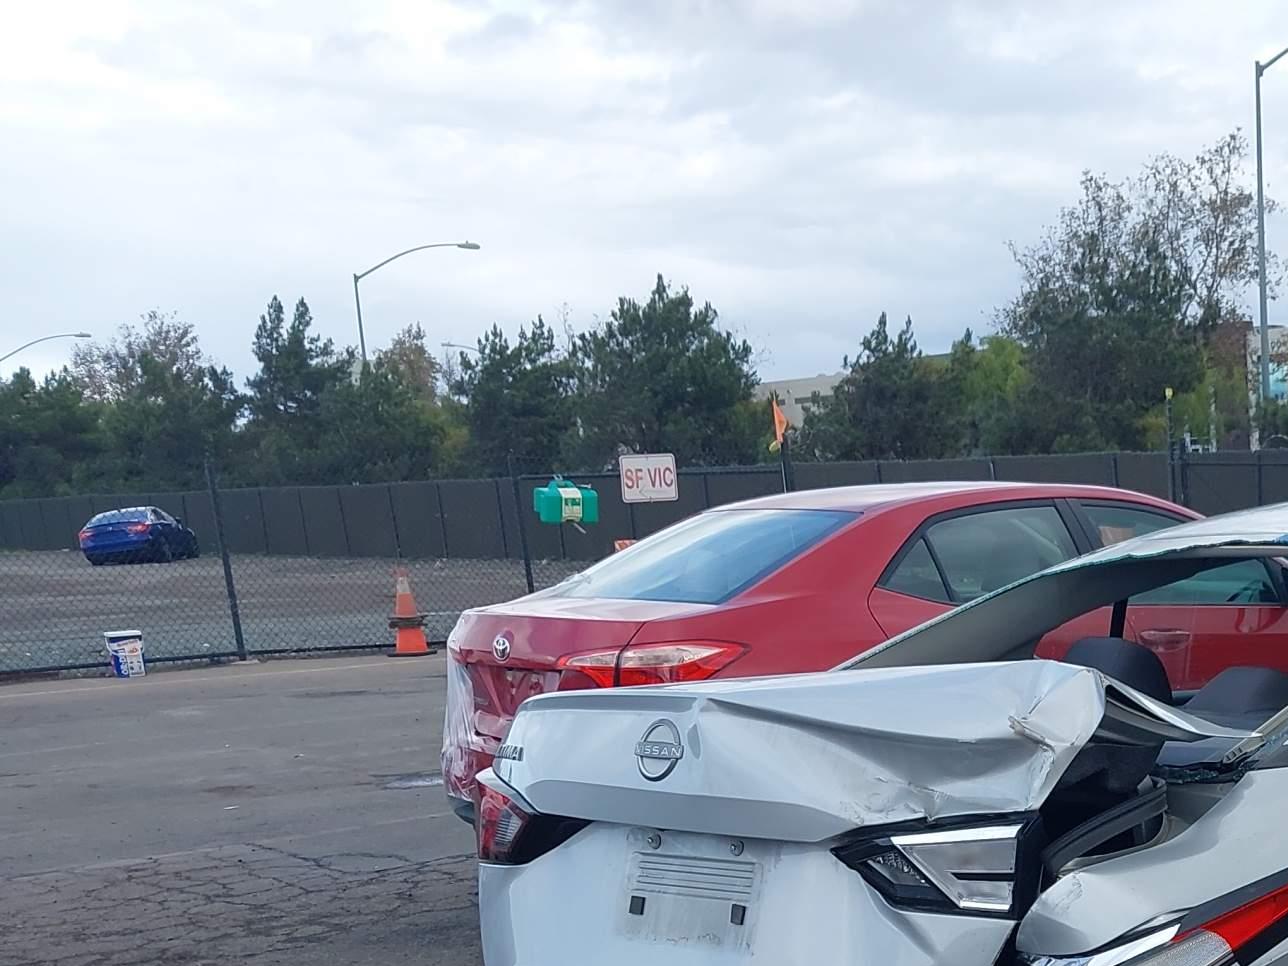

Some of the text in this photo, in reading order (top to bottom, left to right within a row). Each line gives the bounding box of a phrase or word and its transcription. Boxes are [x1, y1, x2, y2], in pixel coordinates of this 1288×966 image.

[625, 467, 674, 489] SF VIC
[636, 744, 681, 758] NISSAN
